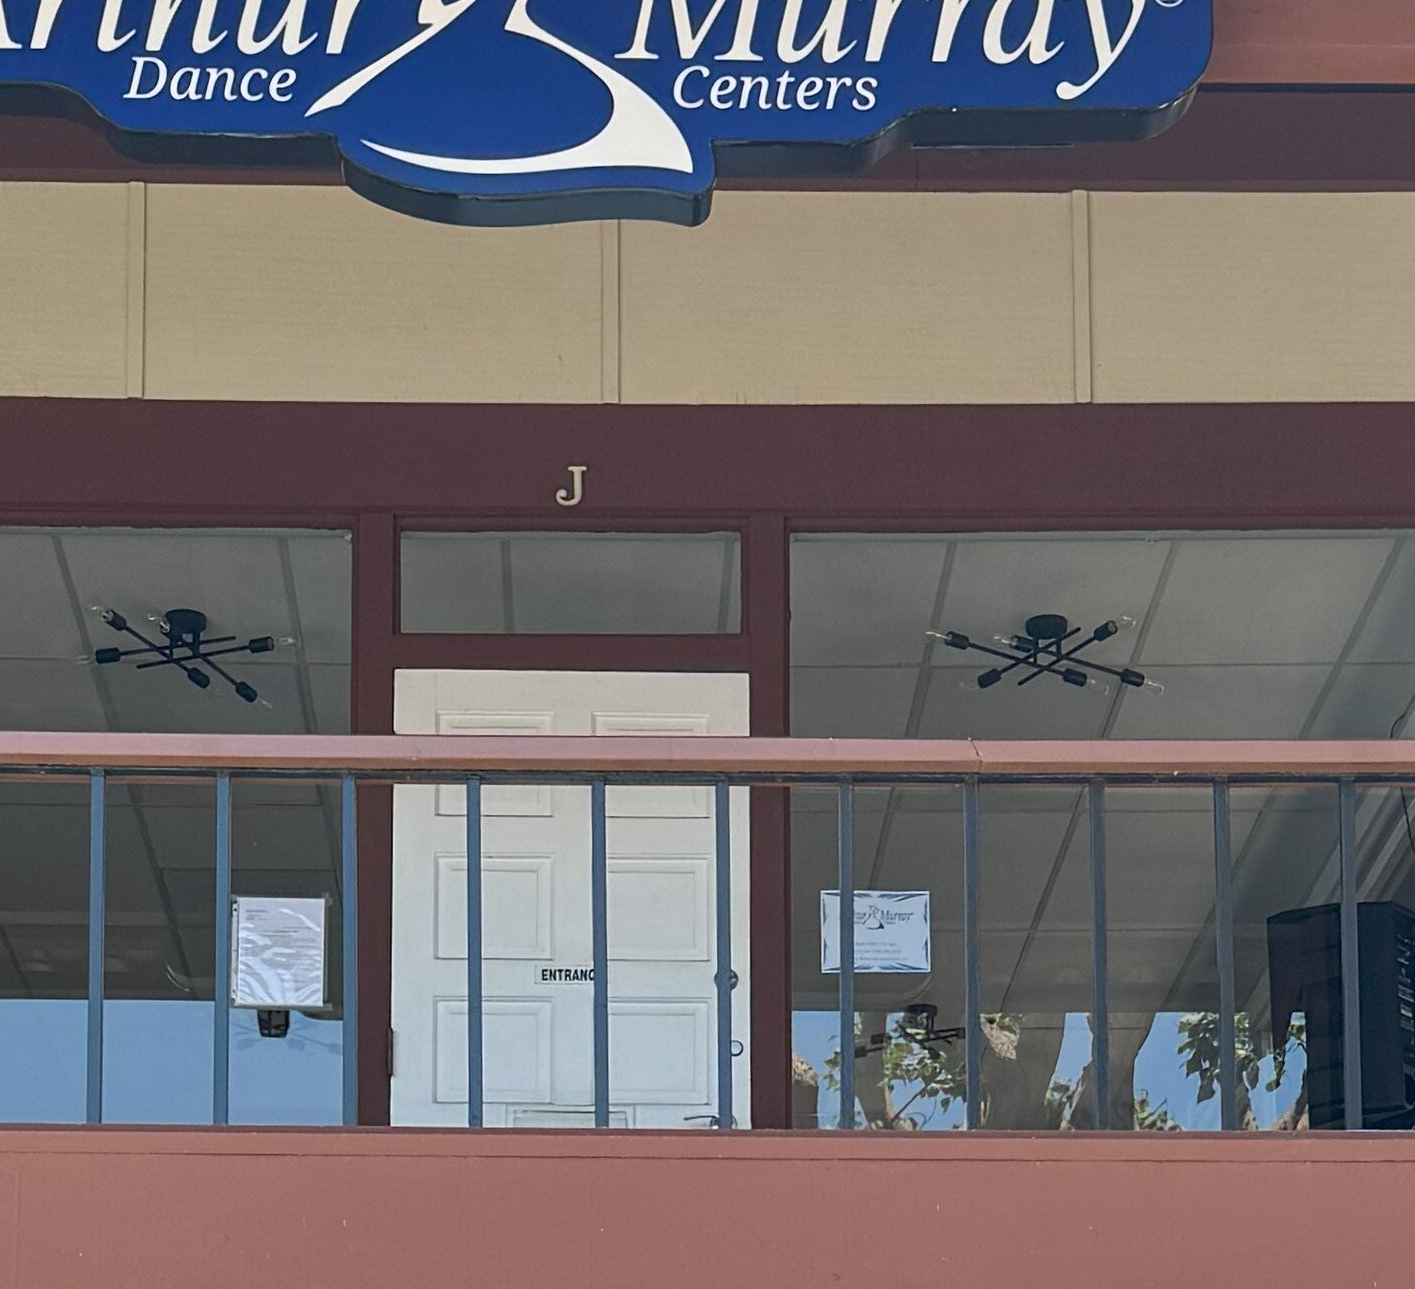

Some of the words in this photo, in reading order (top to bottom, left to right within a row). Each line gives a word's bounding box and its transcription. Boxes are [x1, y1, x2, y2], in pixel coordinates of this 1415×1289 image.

[123, 56, 297, 102] Dance
[673, 65, 878, 110] Centers
[555, 465, 588, 506] J
[541, 968, 595, 982] ENTRANC
